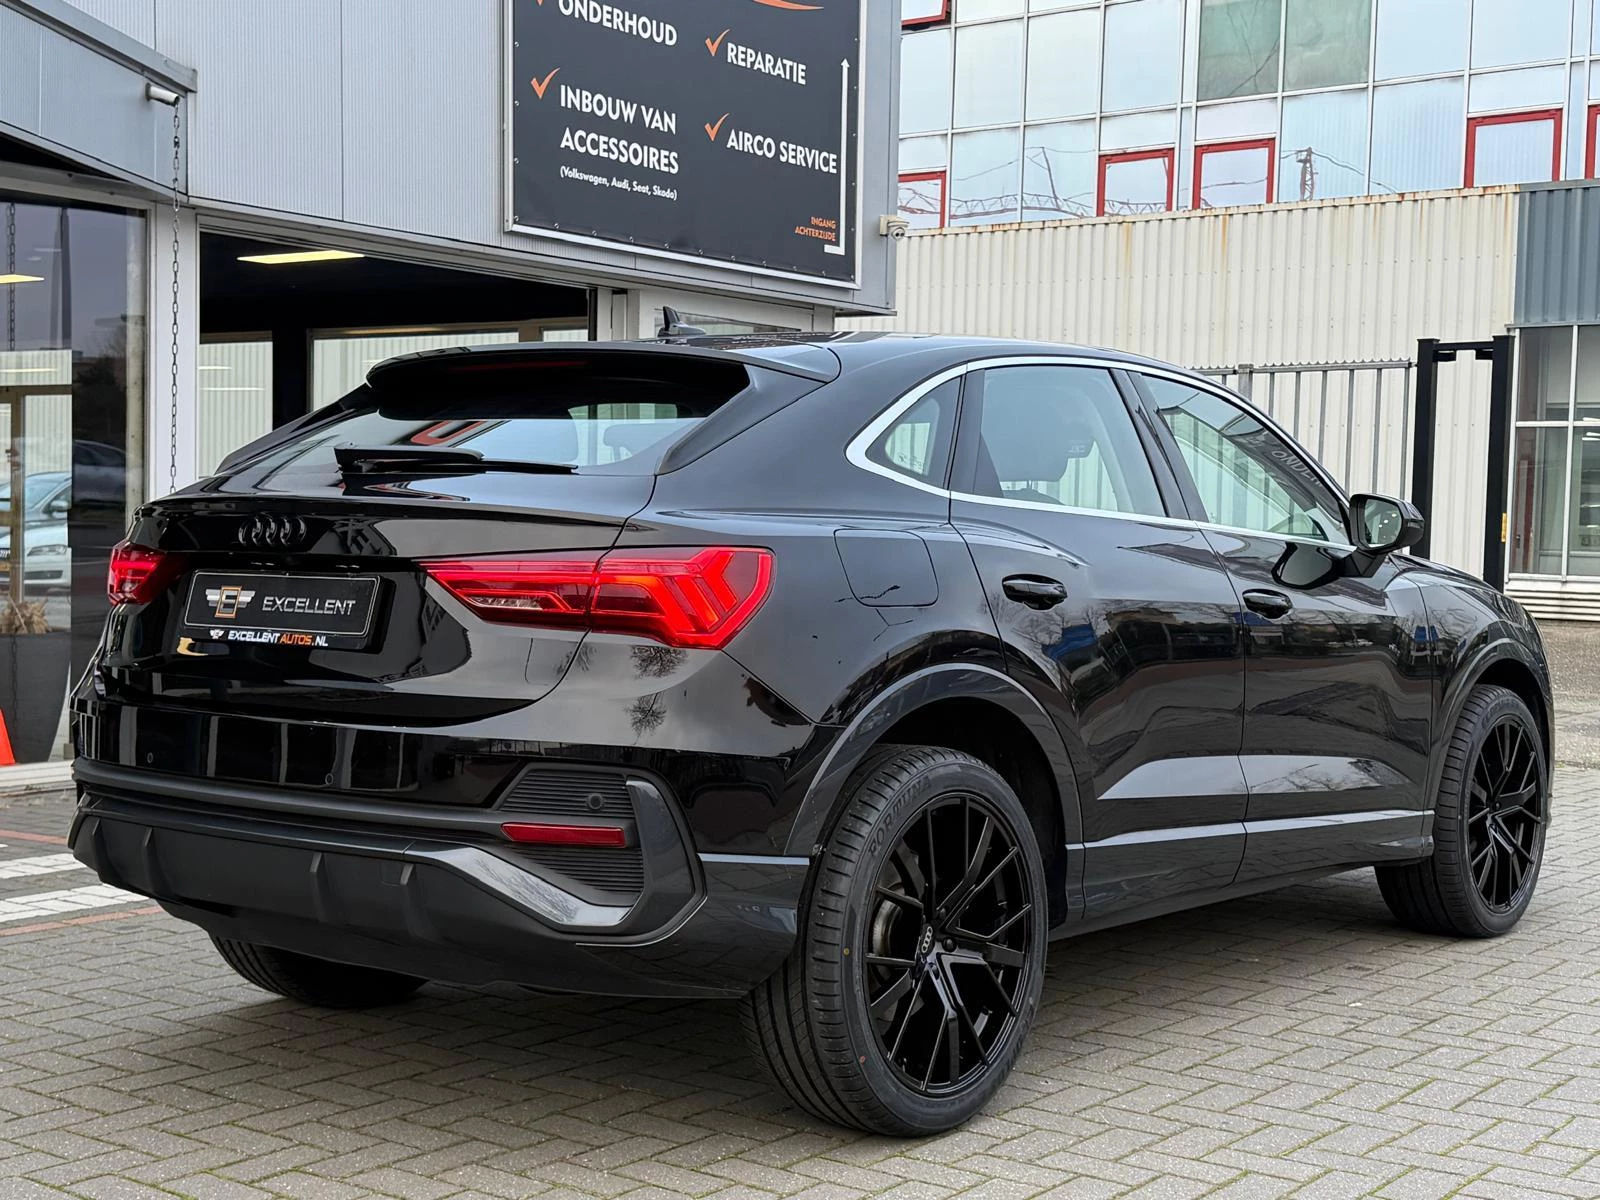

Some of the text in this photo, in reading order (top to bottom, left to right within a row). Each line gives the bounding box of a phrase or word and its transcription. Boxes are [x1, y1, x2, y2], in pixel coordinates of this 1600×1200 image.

[558, 0, 677, 46] ONDERHOUD
[727, 42, 806, 85] REPARATIE
[560, 84, 676, 135] INBOUW VAN
[560, 127, 679, 174] ACCESSOIRES
[726, 129, 837, 174] AIRCO SERVICE
[560, 165, 678, 201] (Volkswagen, Audi, Seat, Skoda)
[811, 216, 836, 229] INGANG
[262, 596, 356, 616] EXCELLENT
[227, 630, 329, 647] EXCELLENTAUTOS.NL
